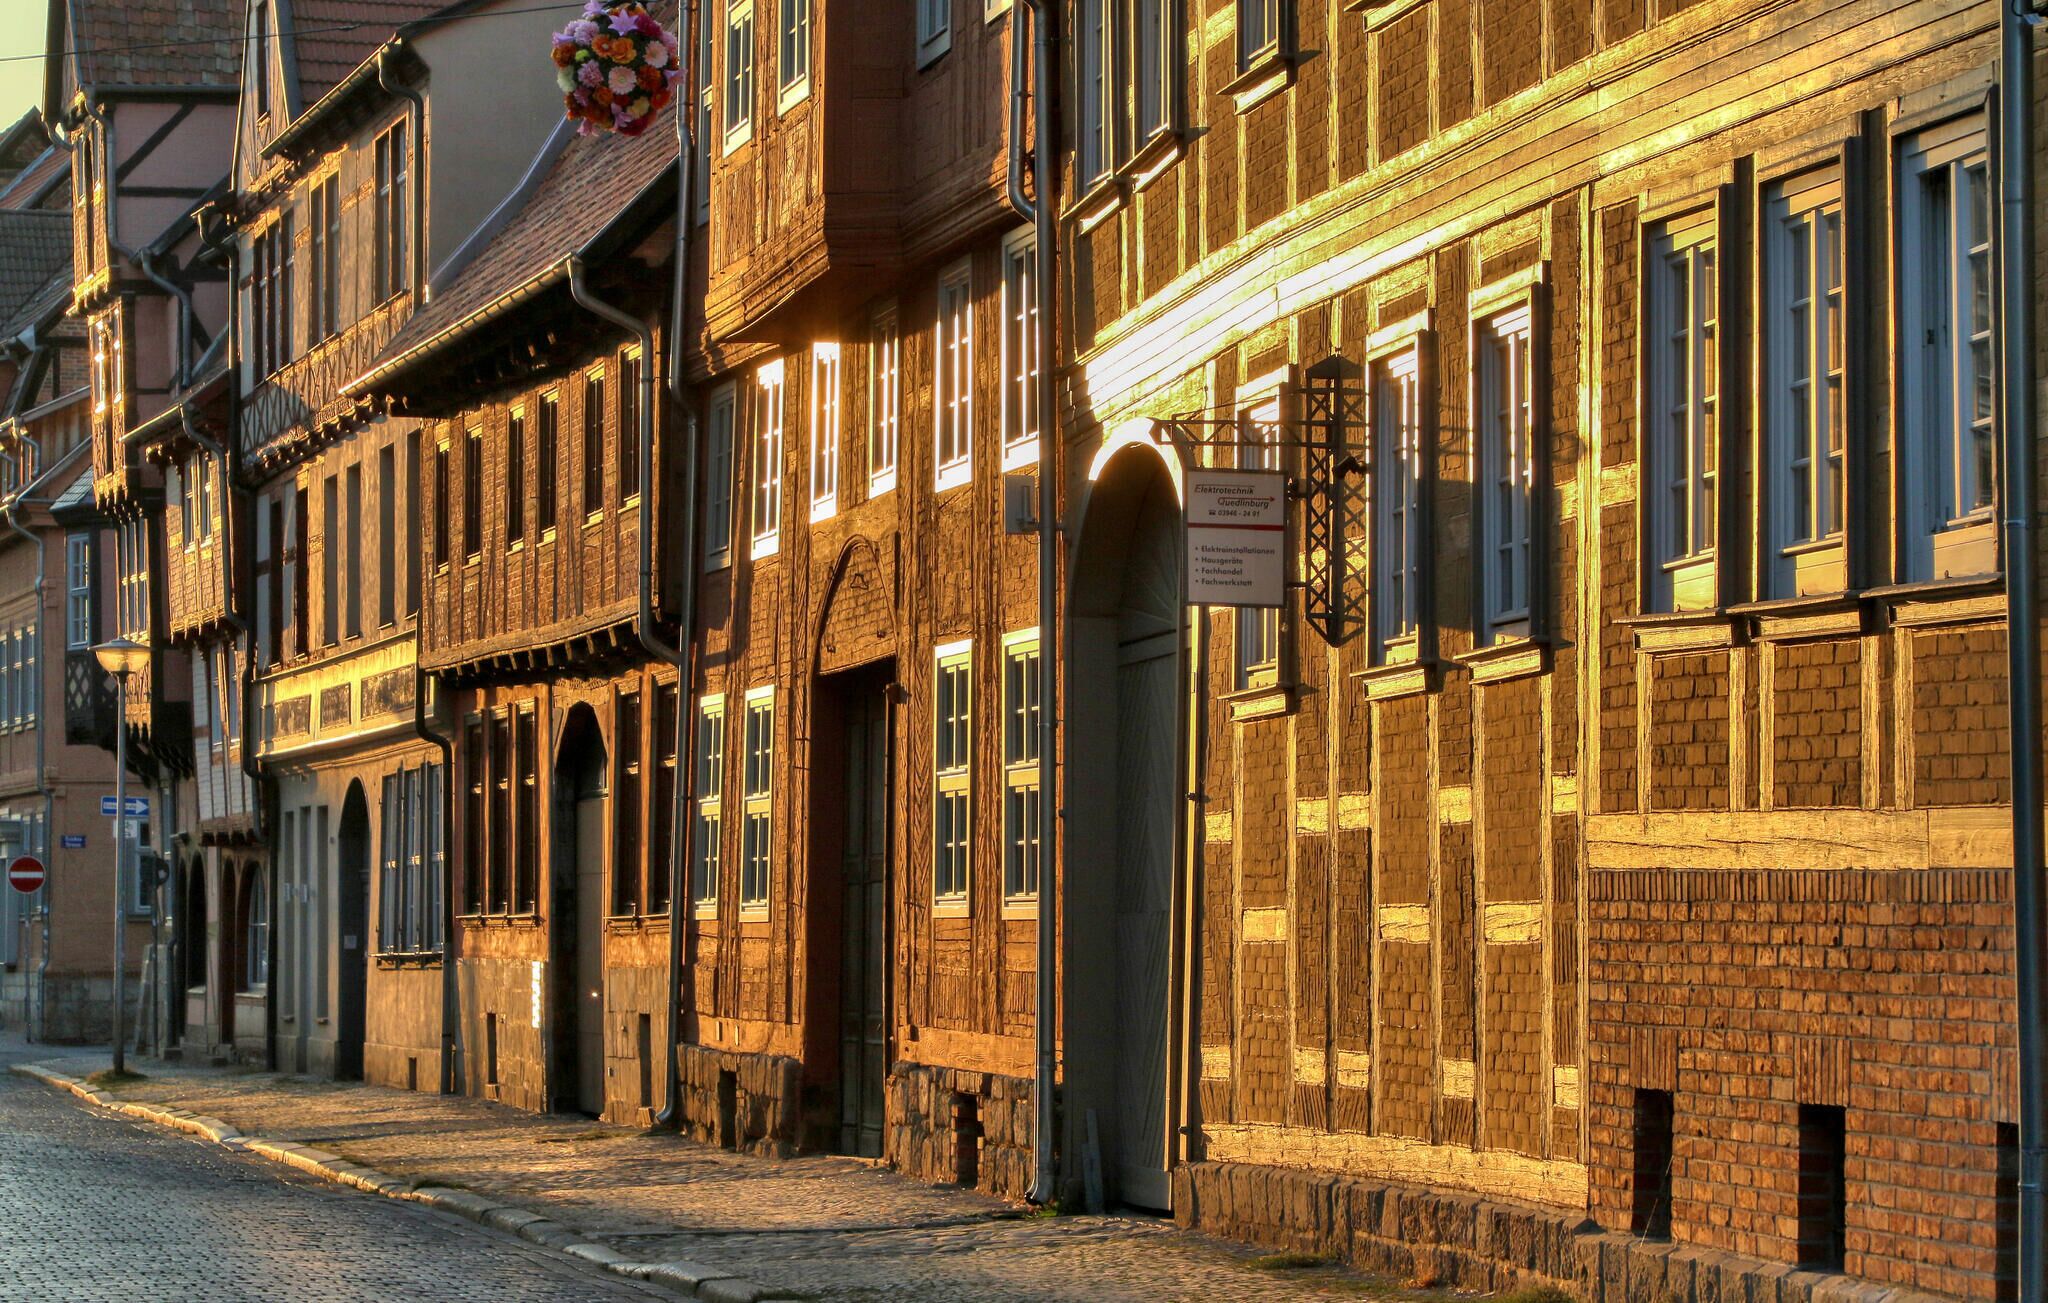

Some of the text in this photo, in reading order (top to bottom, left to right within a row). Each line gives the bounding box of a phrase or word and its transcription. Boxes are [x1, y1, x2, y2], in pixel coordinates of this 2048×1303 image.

[1194, 484, 1254, 494] Elektrotechnik
[1218, 497, 1269, 509] Quedlinburg
[1201, 545, 1275, 554] Elektroinstallationen
[1201, 556, 1243, 565] Hausgeräte
[1201, 567, 1243, 575] Fachhandel
[1201, 578, 1253, 586] Fachwerkstatt
